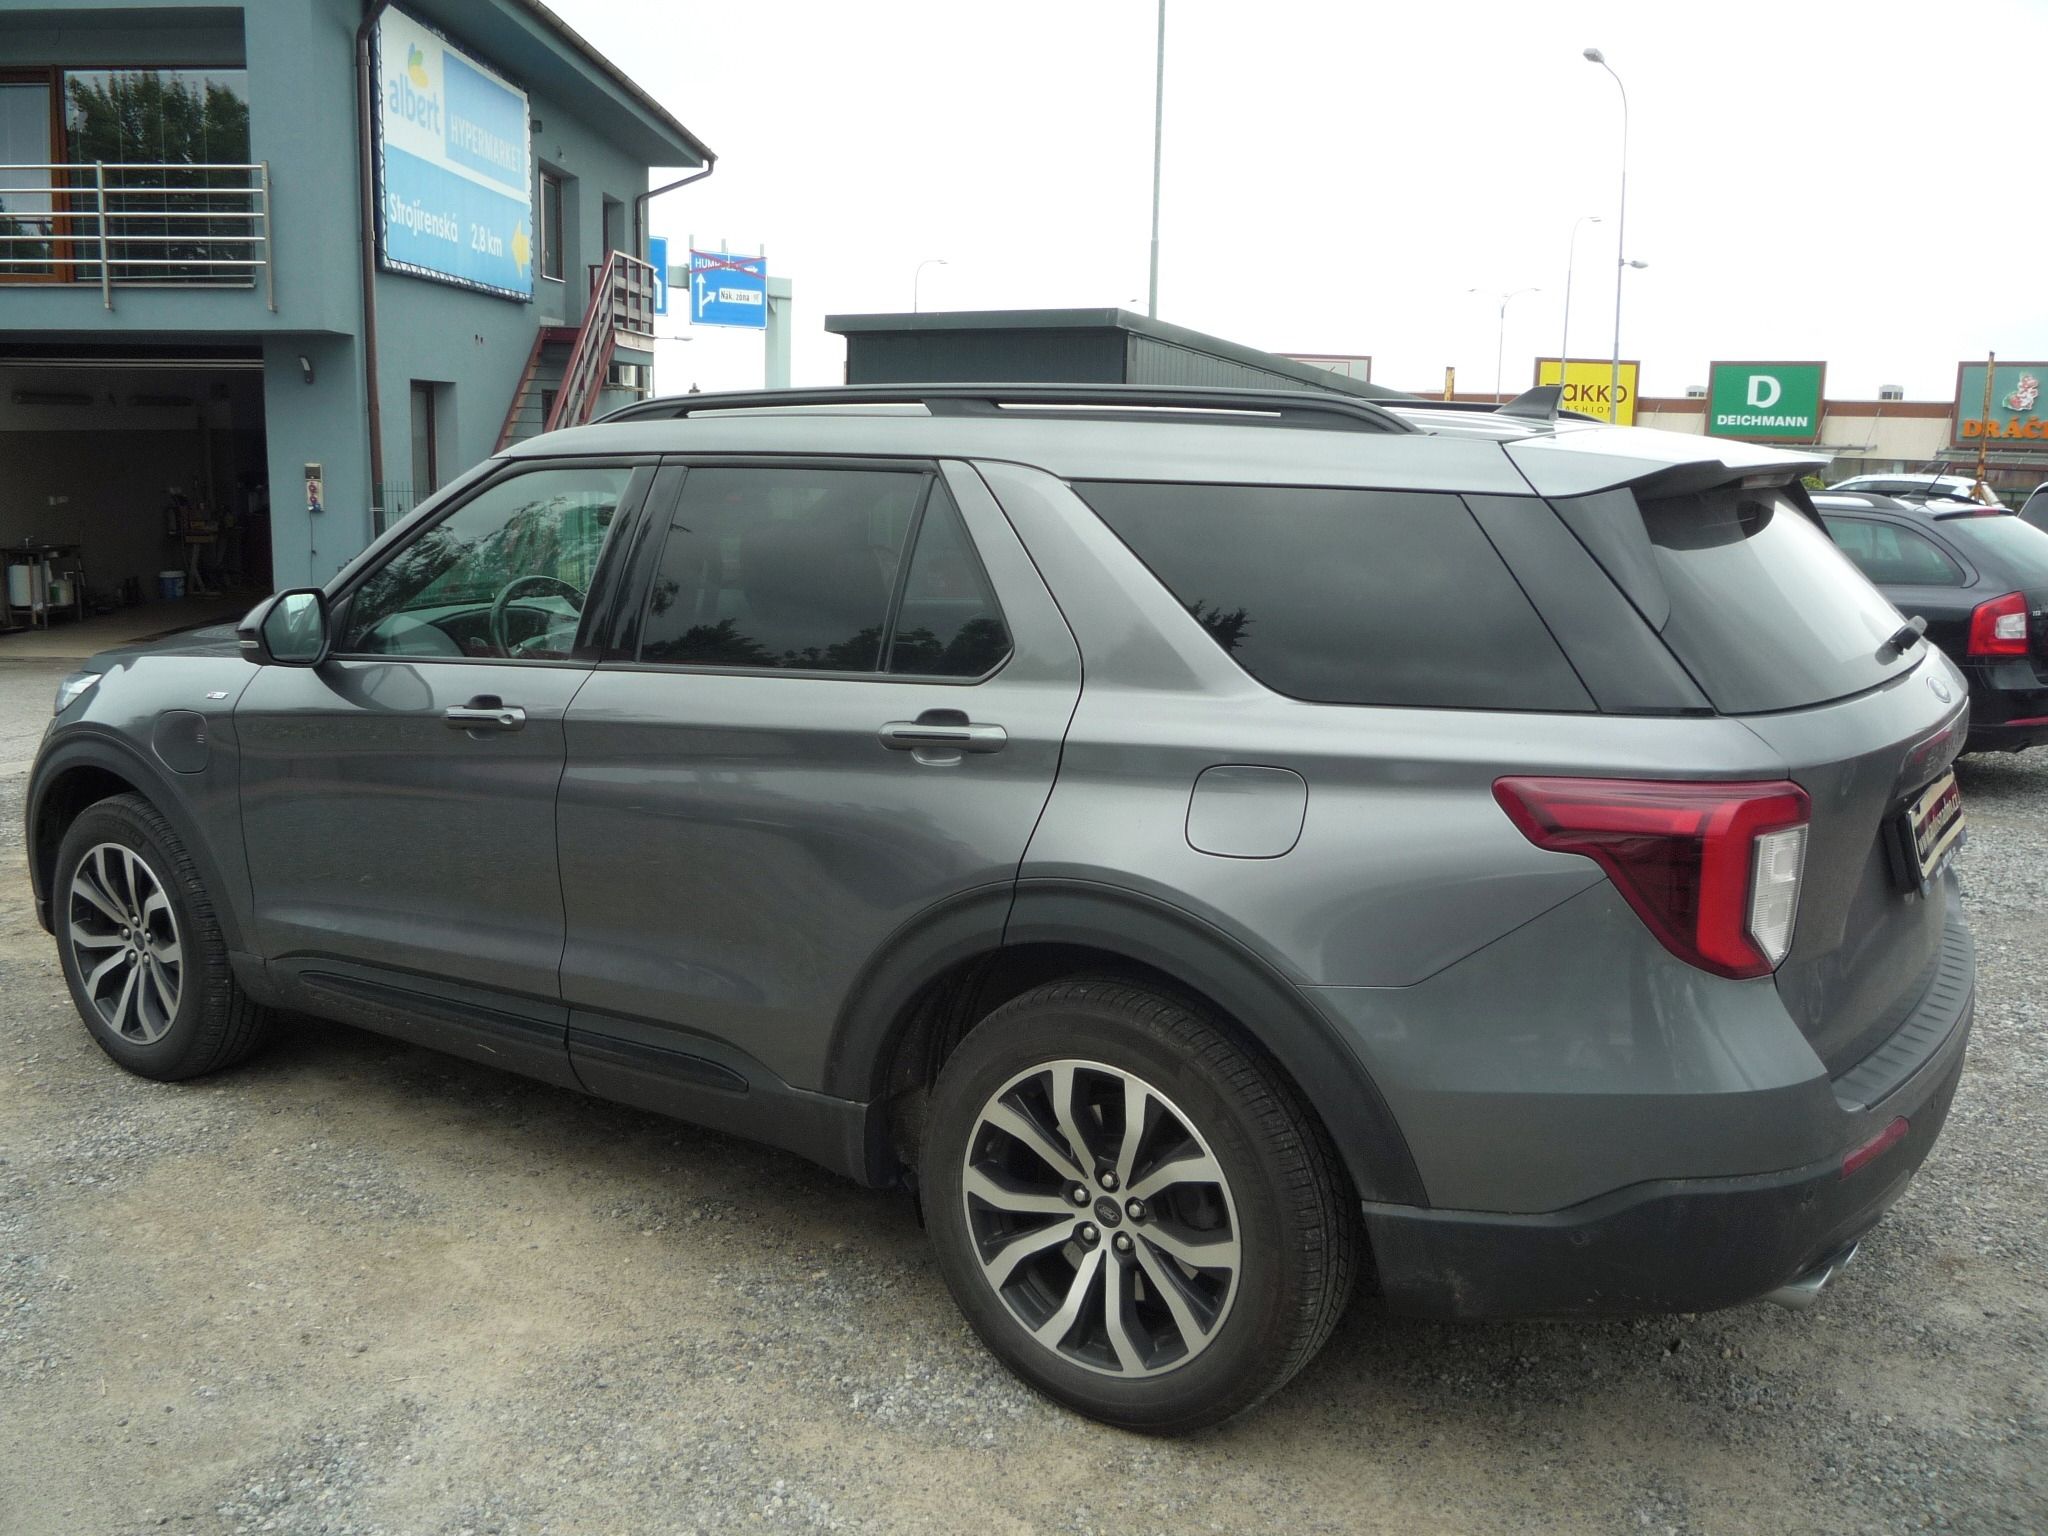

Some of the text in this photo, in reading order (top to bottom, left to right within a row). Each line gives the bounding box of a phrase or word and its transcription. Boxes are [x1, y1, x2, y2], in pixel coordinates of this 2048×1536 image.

[389, 73, 440, 136] albert
[451, 114, 521, 172] HYPERMARKET
[390, 193, 503, 257] Strojírenská 2,8 km
[1565, 405, 1613, 413] ASHION
[1747, 375, 1781, 408] D
[1717, 415, 1808, 427] DEICHMANN
